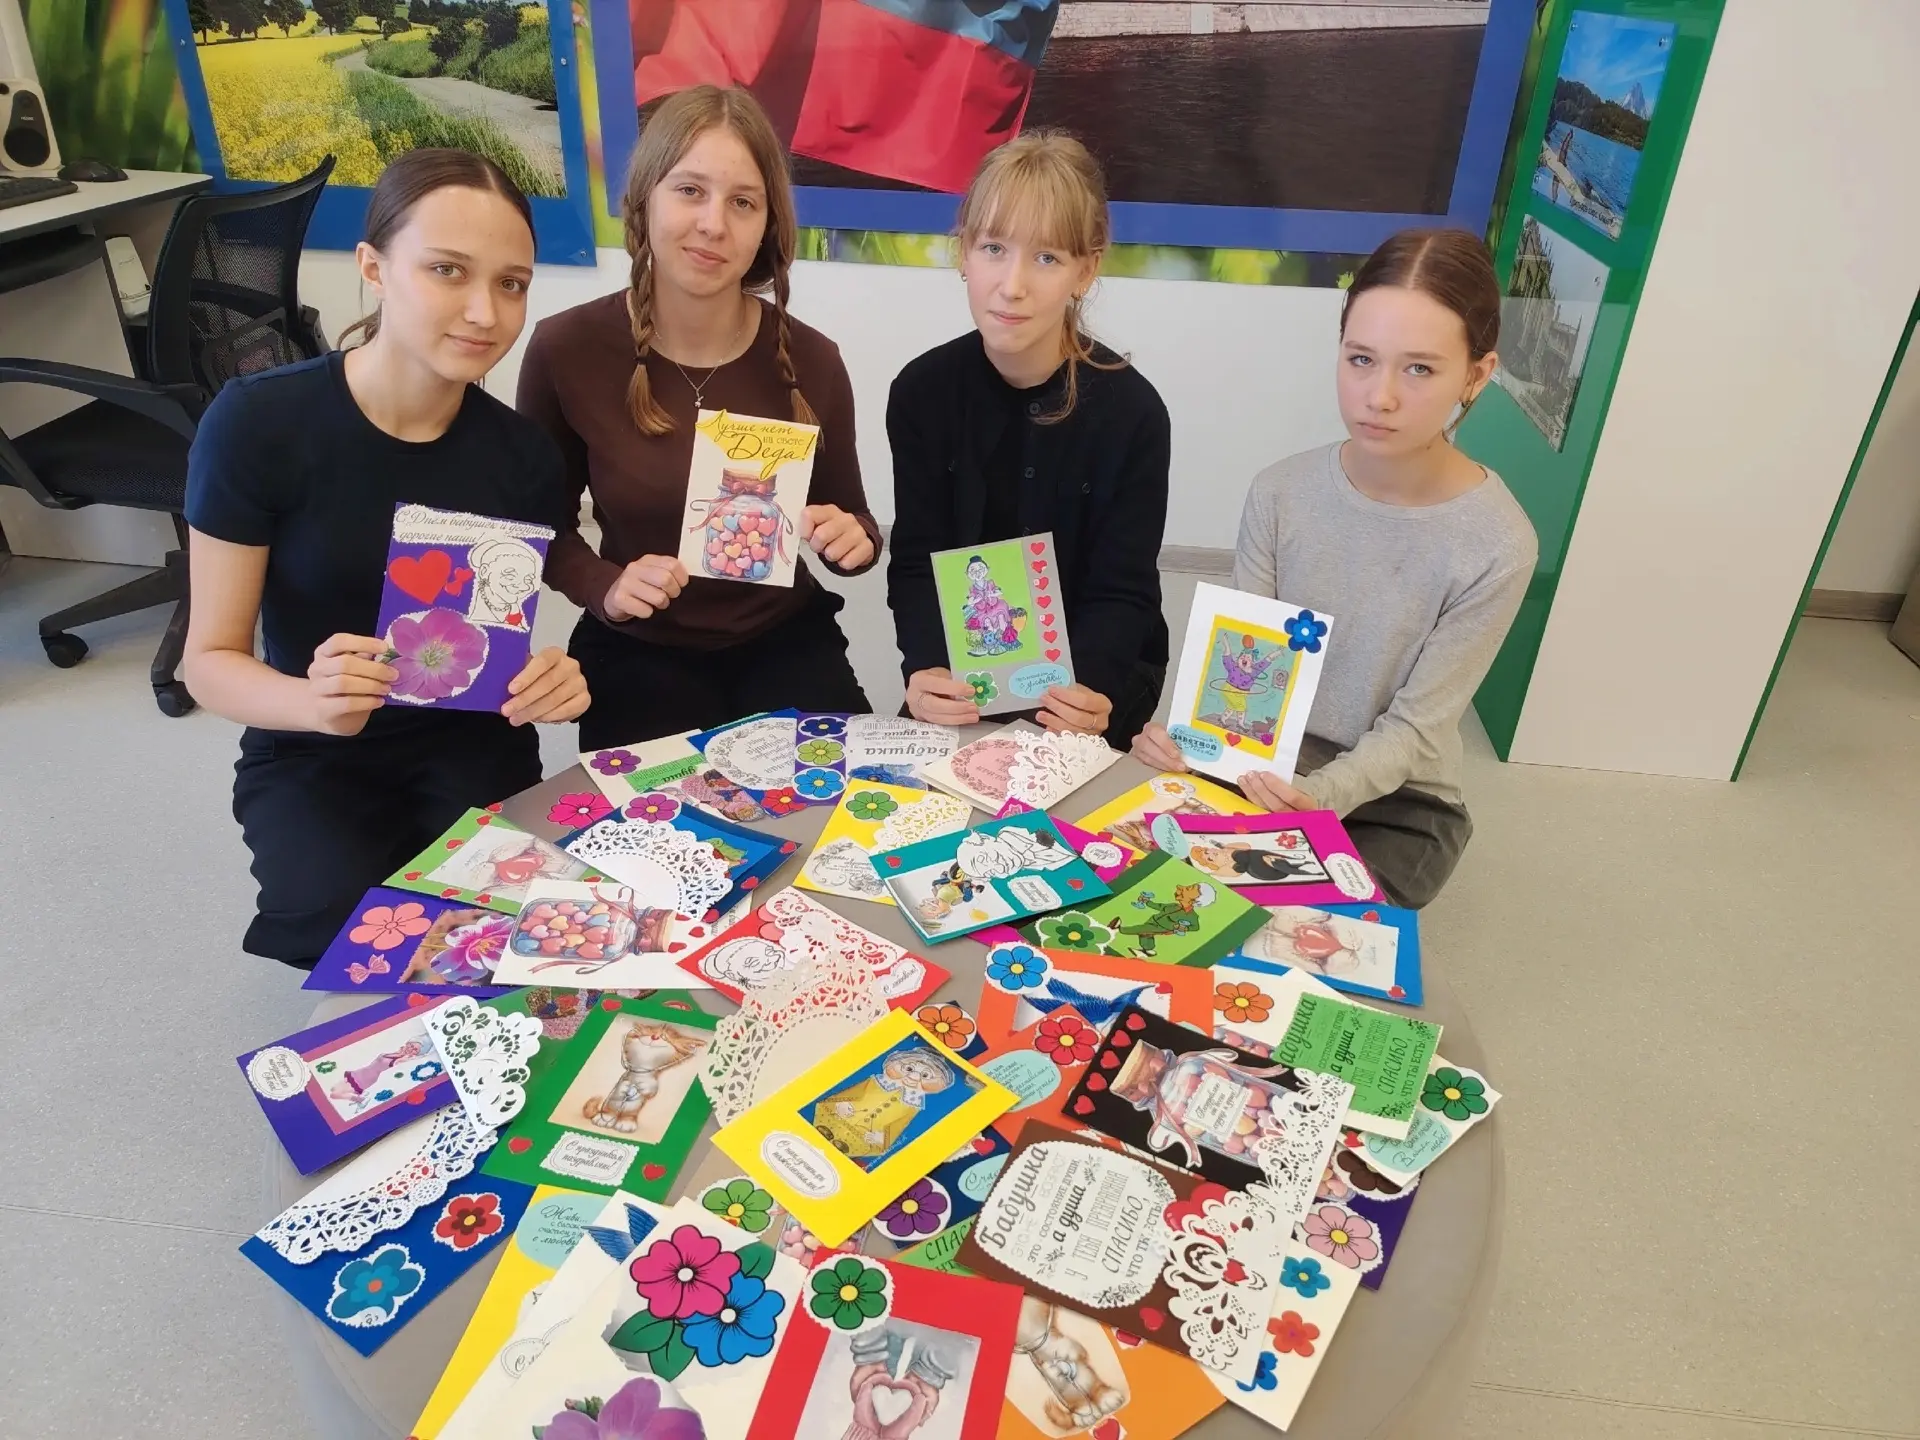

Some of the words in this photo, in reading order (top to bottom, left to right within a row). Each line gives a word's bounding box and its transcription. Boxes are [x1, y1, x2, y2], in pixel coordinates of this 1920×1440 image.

[695, 410, 756, 442] Лучше
[760, 425, 793, 434] нет
[720, 431, 816, 480] Деда!
[449, 515, 496, 530] бабушек
[400, 531, 443, 544] дорогие
[445, 532, 485, 542] наши!
[864, 744, 950, 757] Бабушка
[1279, 998, 1317, 1064] абушка
[1334, 1030, 1355, 1066] душа
[1330, 1063, 1342, 1074] а
[1407, 1064, 1420, 1081] ТЫ
[1401, 1080, 1415, 1098] ЧТО
[566, 1140, 579, 1150] С
[575, 1145, 623, 1161] праздником
[980, 1146, 1049, 1248] Бабушка
[1059, 1185, 1087, 1232] душа
[1038, 1184, 1068, 1239] СОСТОЯНИЕ
[925, 1220, 974, 1261] СПАС
[1052, 1231, 1067, 1243] а
[1100, 1195, 1148, 1274] СПАСИБО,
[1125, 1253, 1145, 1278] ЧТО
